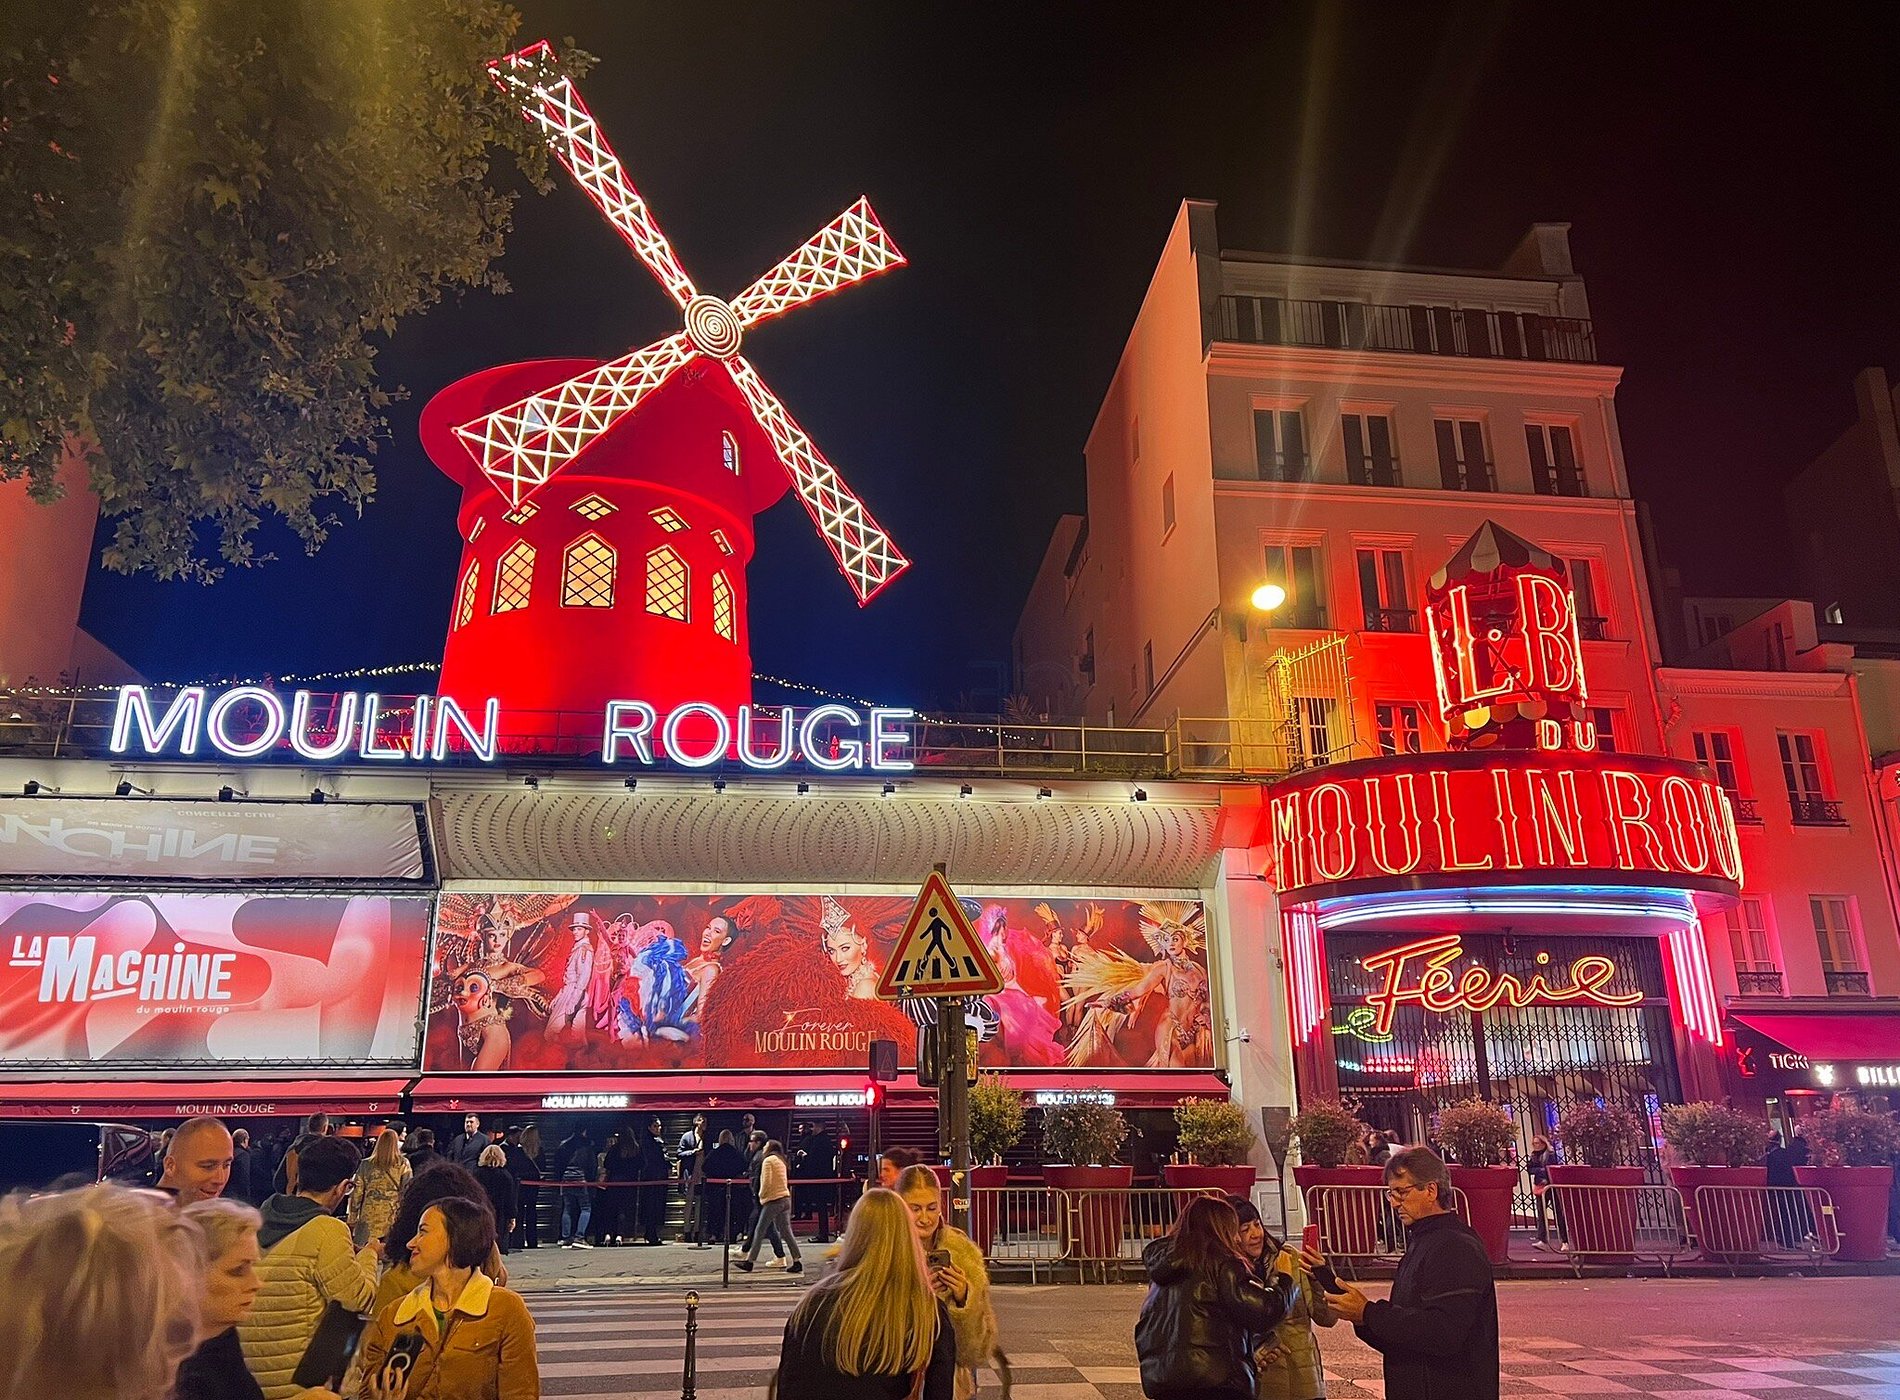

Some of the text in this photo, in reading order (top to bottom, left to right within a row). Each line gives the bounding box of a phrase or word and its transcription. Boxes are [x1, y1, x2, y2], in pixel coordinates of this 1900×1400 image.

[109, 684, 914, 771] MOULIN ROUGE
[1540, 719, 1596, 752] DU
[1271, 768, 1744, 893] MOULIN ROU
[11, 936, 42, 960] LA
[1362, 934, 1644, 1035] Féerie
[136, 1005, 230, 1015] du moulin rouge
[773, 1007, 854, 1034] Forever
[754, 1031, 817, 1053] MOULIN
[1857, 1066, 1900, 1086] BILL
[175, 1103, 276, 1114] MOULIN ROUGE
[541, 1095, 628, 1109] MOULIN ROUGE
[795, 1094, 867, 1106] MOULIN ROU
